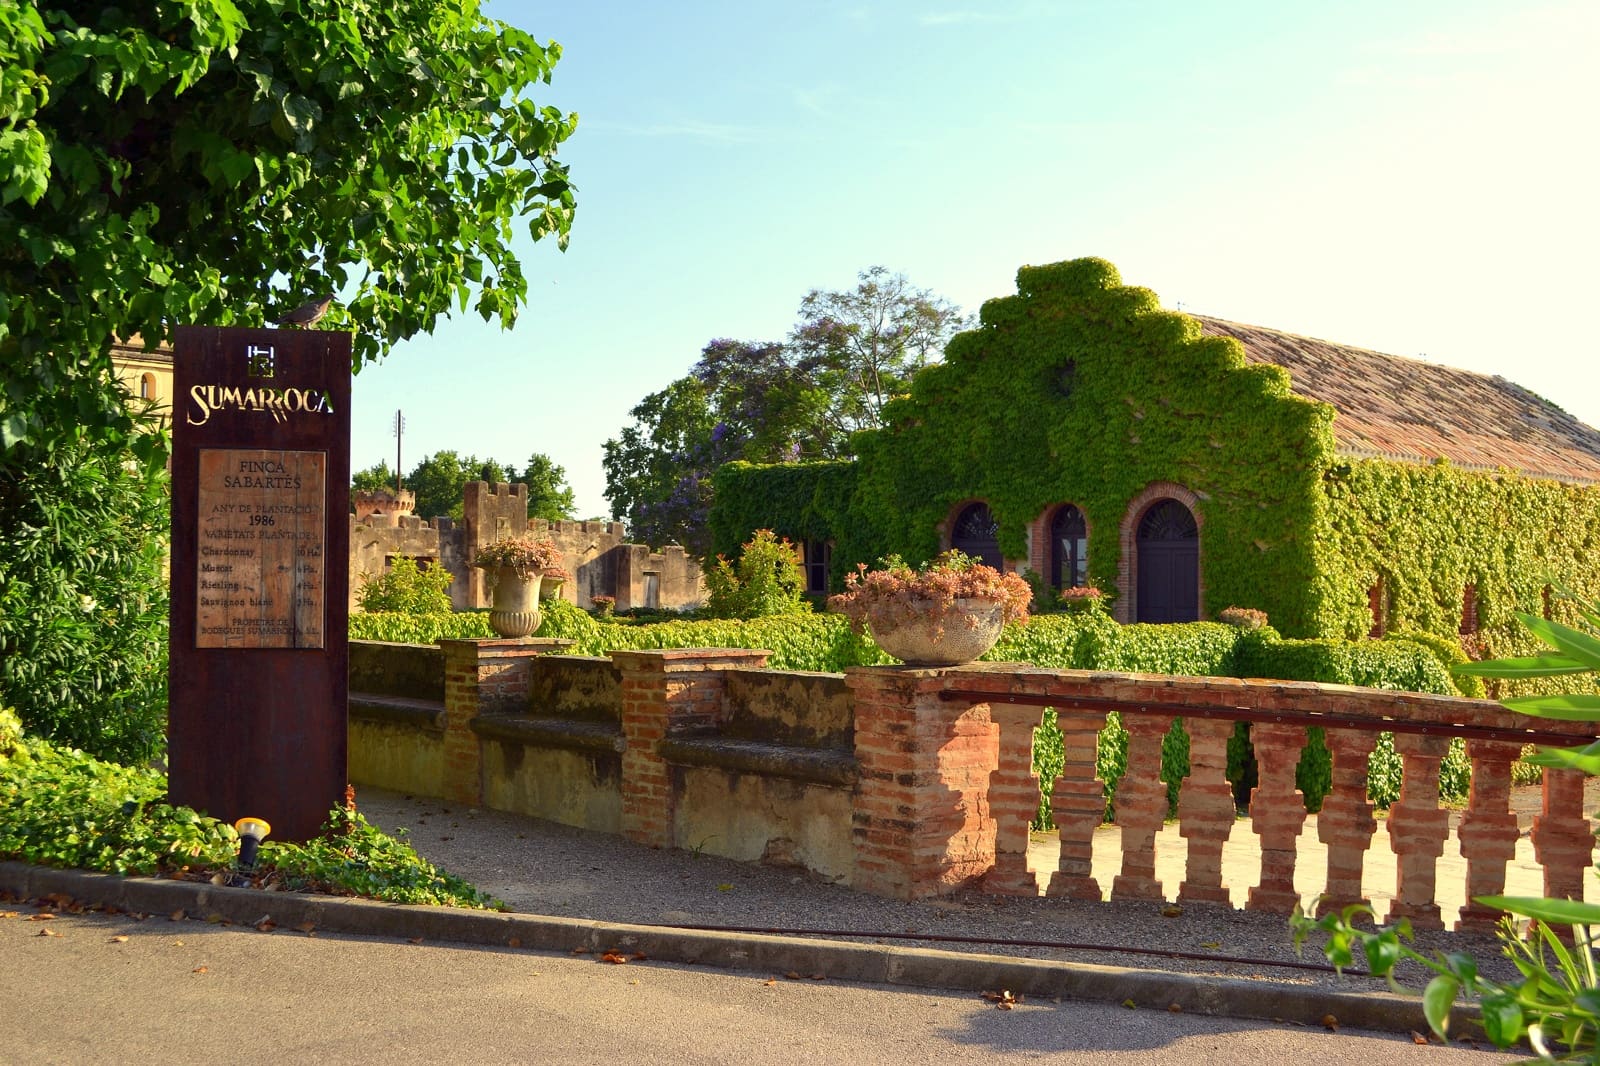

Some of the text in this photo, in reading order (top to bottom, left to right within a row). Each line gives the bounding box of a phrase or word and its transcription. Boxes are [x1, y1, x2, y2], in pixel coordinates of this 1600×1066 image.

[187, 384, 334, 426] SUMARROCA
[239, 461, 286, 473] FINCA
[224, 474, 302, 489] SABARTÉS
[212, 504, 237, 513] ANY
[239, 504, 252, 513] DE
[249, 515, 275, 526] 1986
[204, 530, 256, 539] VARIETATS
[201, 547, 255, 559] Chardonnay
[201, 563, 233, 572] Muscat
[201, 581, 239, 591] Riesling
[200, 597, 245, 608] Sauvignon
[249, 597, 273, 606] blanc
